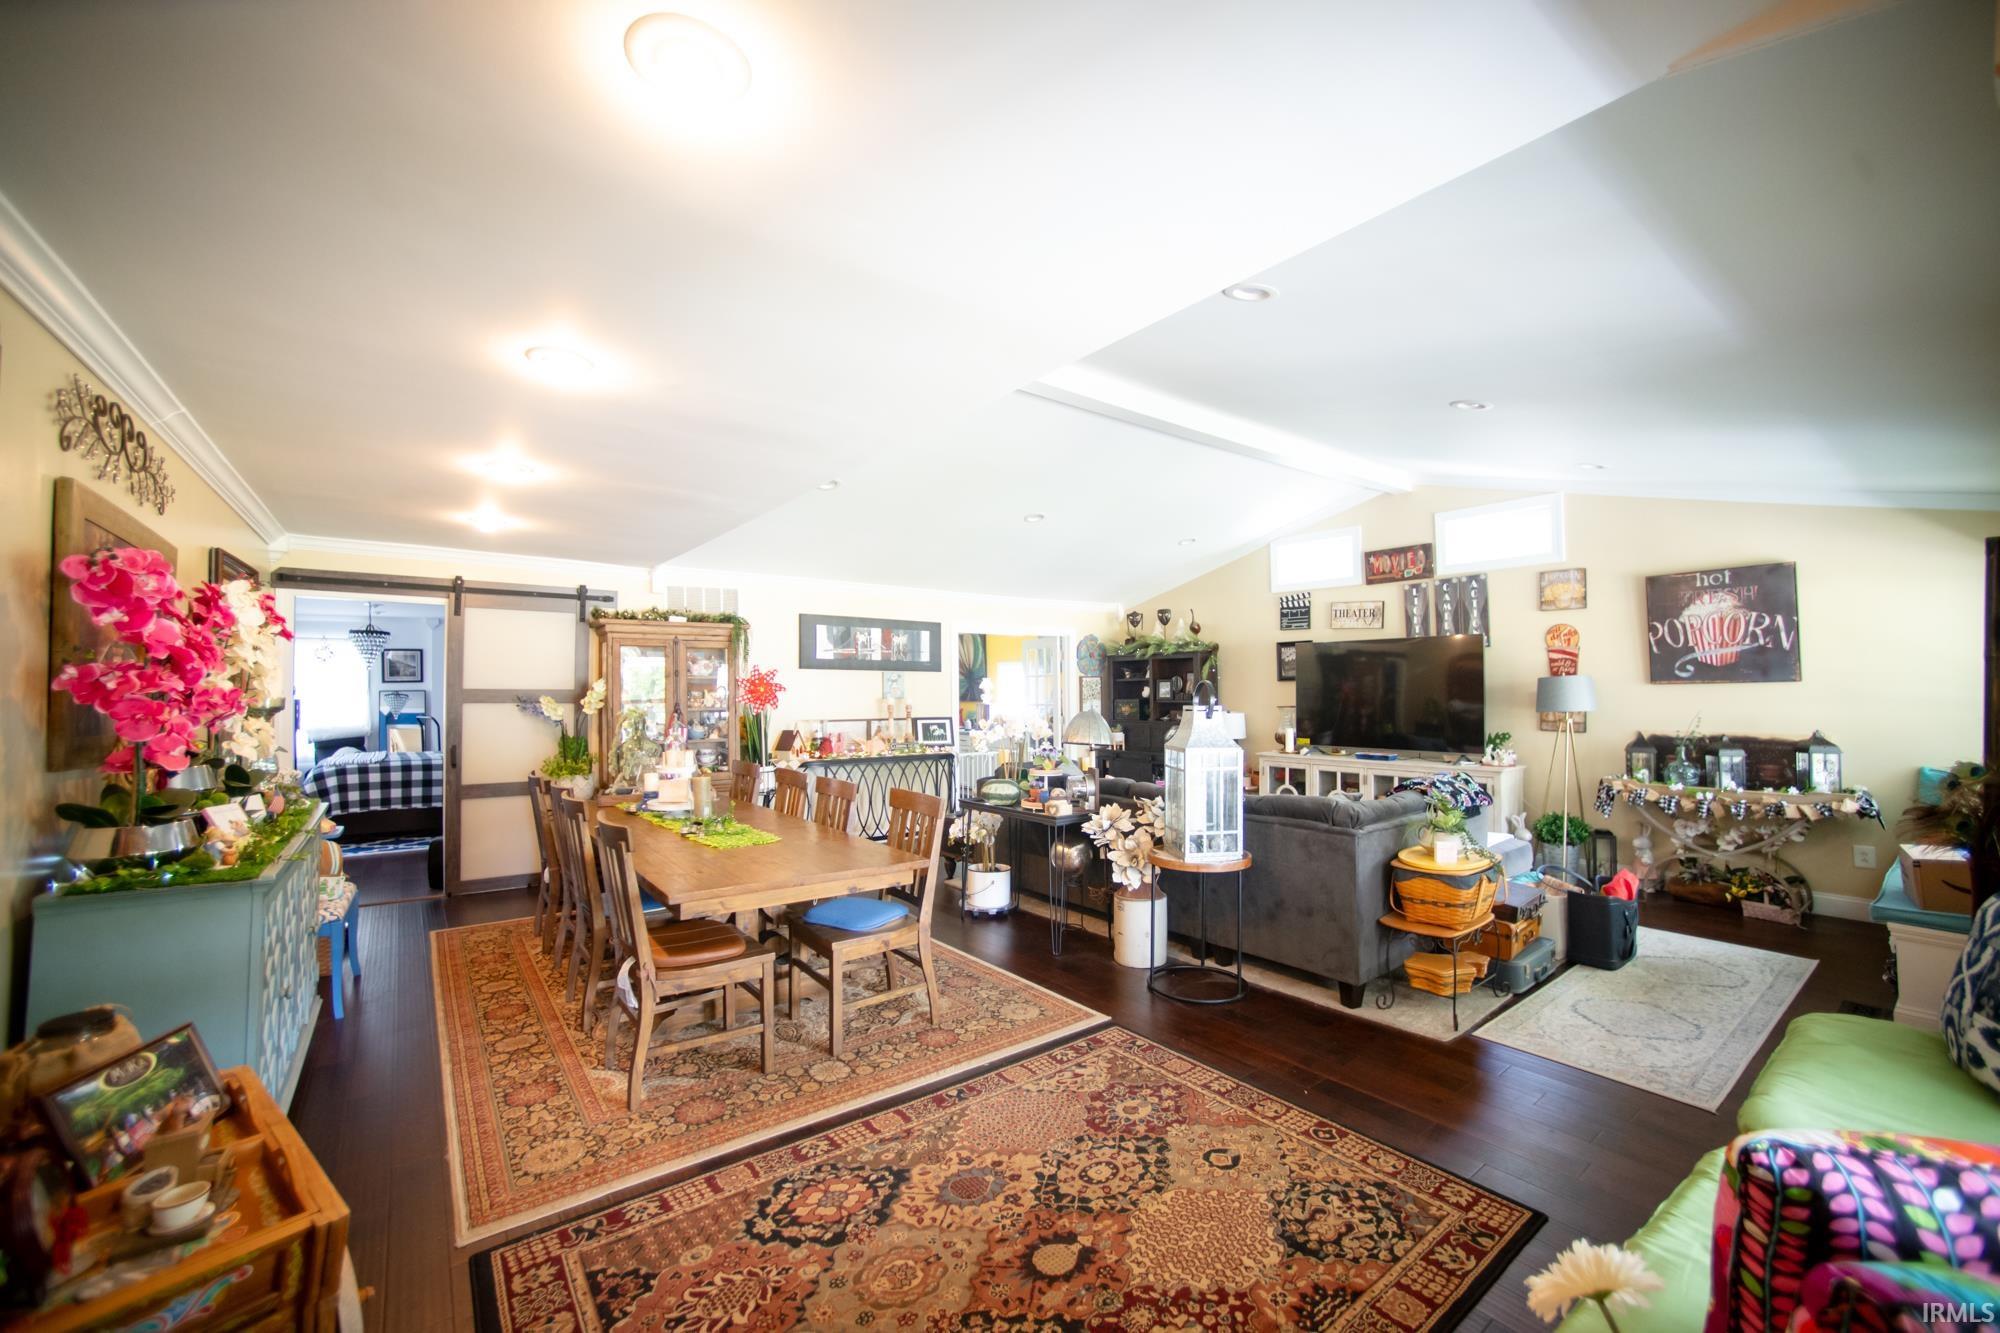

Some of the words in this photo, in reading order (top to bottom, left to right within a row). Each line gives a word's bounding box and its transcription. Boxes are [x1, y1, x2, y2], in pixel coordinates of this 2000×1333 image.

[1696, 569, 1732, 587] hot
[1332, 608, 1376, 618] THEATER
[1412, 588, 1421, 637] LIGHT
[1649, 611, 1798, 654] POPCORN
